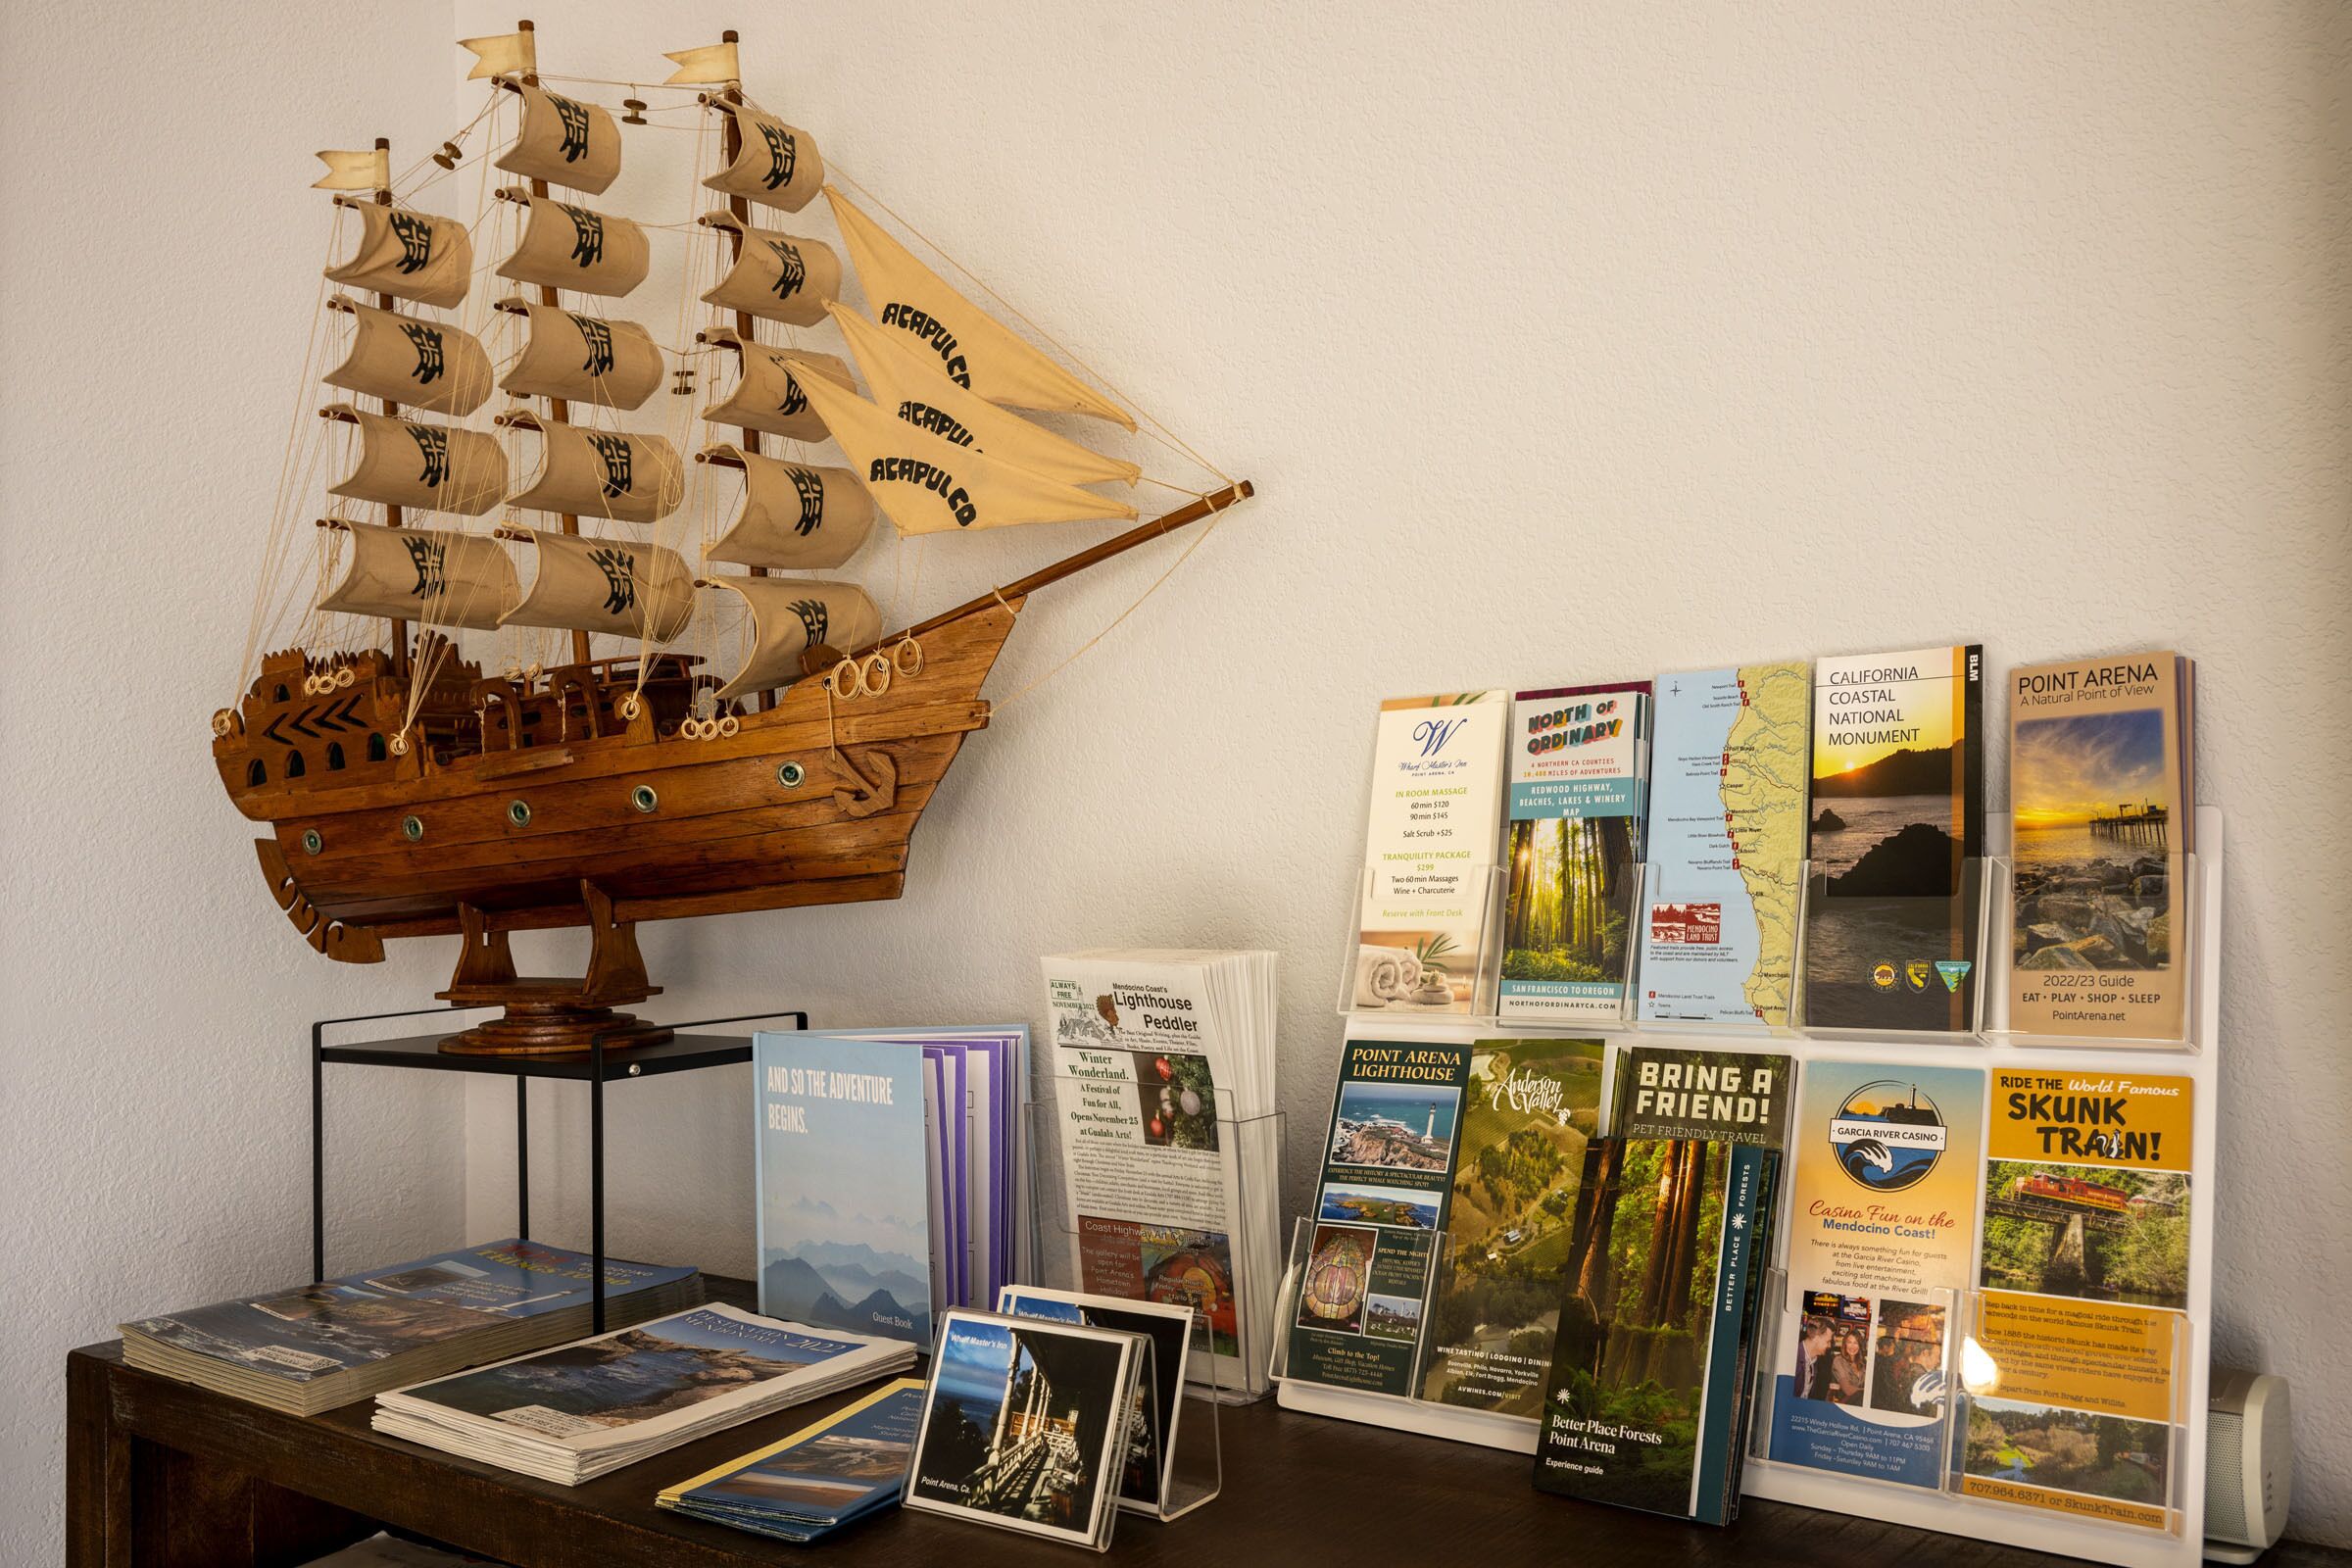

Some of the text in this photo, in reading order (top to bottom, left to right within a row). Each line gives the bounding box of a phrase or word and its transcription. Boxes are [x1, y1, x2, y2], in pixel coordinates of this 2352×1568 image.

[898, 401, 984, 454] ACAPUL
[870, 458, 977, 527] ACAPULCO
[1830, 666, 1918, 685] CALIFORNIA
[2019, 663, 2158, 695] POINT ARENA
[1830, 690, 1896, 705] COASTAL
[2021, 685, 2155, 706] A Natural Point of View
[1529, 700, 1617, 734] NORTH OF
[1830, 710, 1904, 725] NATIONAL
[1413, 718, 1467, 757] W
[1528, 718, 1623, 756] ORDINARY
[1829, 729, 1920, 745] MONUMENT
[1532, 785, 1570, 795] REDWOOD
[1520, 798, 1554, 807] BEACHES,
[1528, 985, 1568, 994] FRANCISCO
[2043, 975, 2133, 987] 2022/23 Guide
[1113, 992, 1193, 1010] Lighthouse
[1509, 1001, 1615, 1009] NORTHOFORDINARYCA.COM
[2023, 993, 2160, 1003] EAT PLAY SHOP SLEEP
[1144, 1014, 1198, 1031] Peddler
[2053, 1010, 2125, 1021] PointArena.net
[1079, 1052, 1112, 1064] Winter
[1352, 1049, 1460, 1065] POINT ARENA
[1068, 1065, 1129, 1080] Wonderland.
[1353, 1064, 1455, 1081] LIGHTHOUSE
[1640, 1062, 1772, 1094] BRING A
[767, 1065, 893, 1105] AND SO THE ADVENTURE
[1087, 1084, 1111, 1094] Festival
[1493, 1068, 1561, 1111] Anderson
[2000, 1077, 2180, 1097] RIDE THE World Famous
[1083, 1099, 1121, 1110] Fun for All,
[1519, 1093, 1563, 1113] Valley
[1637, 1090, 1770, 1124] FRIEND!
[2008, 1093, 2128, 1126] SKUNK
[768, 1103, 808, 1134] BEGINS.
[1071, 1112, 1139, 1125] Opens November 25
[1088, 1129, 1113, 1138] Gualala
[1115, 1130, 1132, 1140] Arts!
[1634, 1124, 1766, 1144] PET FRIENDLY TRAVEL
[1838, 1127, 1937, 1142] GARCIA RIVER CASINO
[2036, 1127, 2161, 1160] TRAN!
[1810, 1200, 1955, 1228] Casino Fun on the
[1086, 1221, 1152, 1239] Coast Highway
[1726, 1164, 1750, 1311] BETTER PLACE FORESTS
[1823, 1219, 1936, 1239] Mendocino Coast!
[1838, 1243, 1860, 1251] always
[1862, 1245, 1897, 1255] something
[873, 1311, 913, 1329] Guest Book
[952, 1334, 971, 1344] Wharf
[1455, 1348, 1485, 1358] TASTING
[1491, 1354, 1522, 1363] LODGING
[1529, 1358, 1551, 1367] DININ
[1552, 1415, 1662, 1445] Better Place Forests
[1549, 1431, 1615, 1454] Point Arena
[1545, 1458, 1603, 1475] Experience guide
[921, 1476, 971, 1494] Point Arena, Ca.
[1970, 1482, 2163, 1525] 707.964.6371 or SkunkTrain.com
